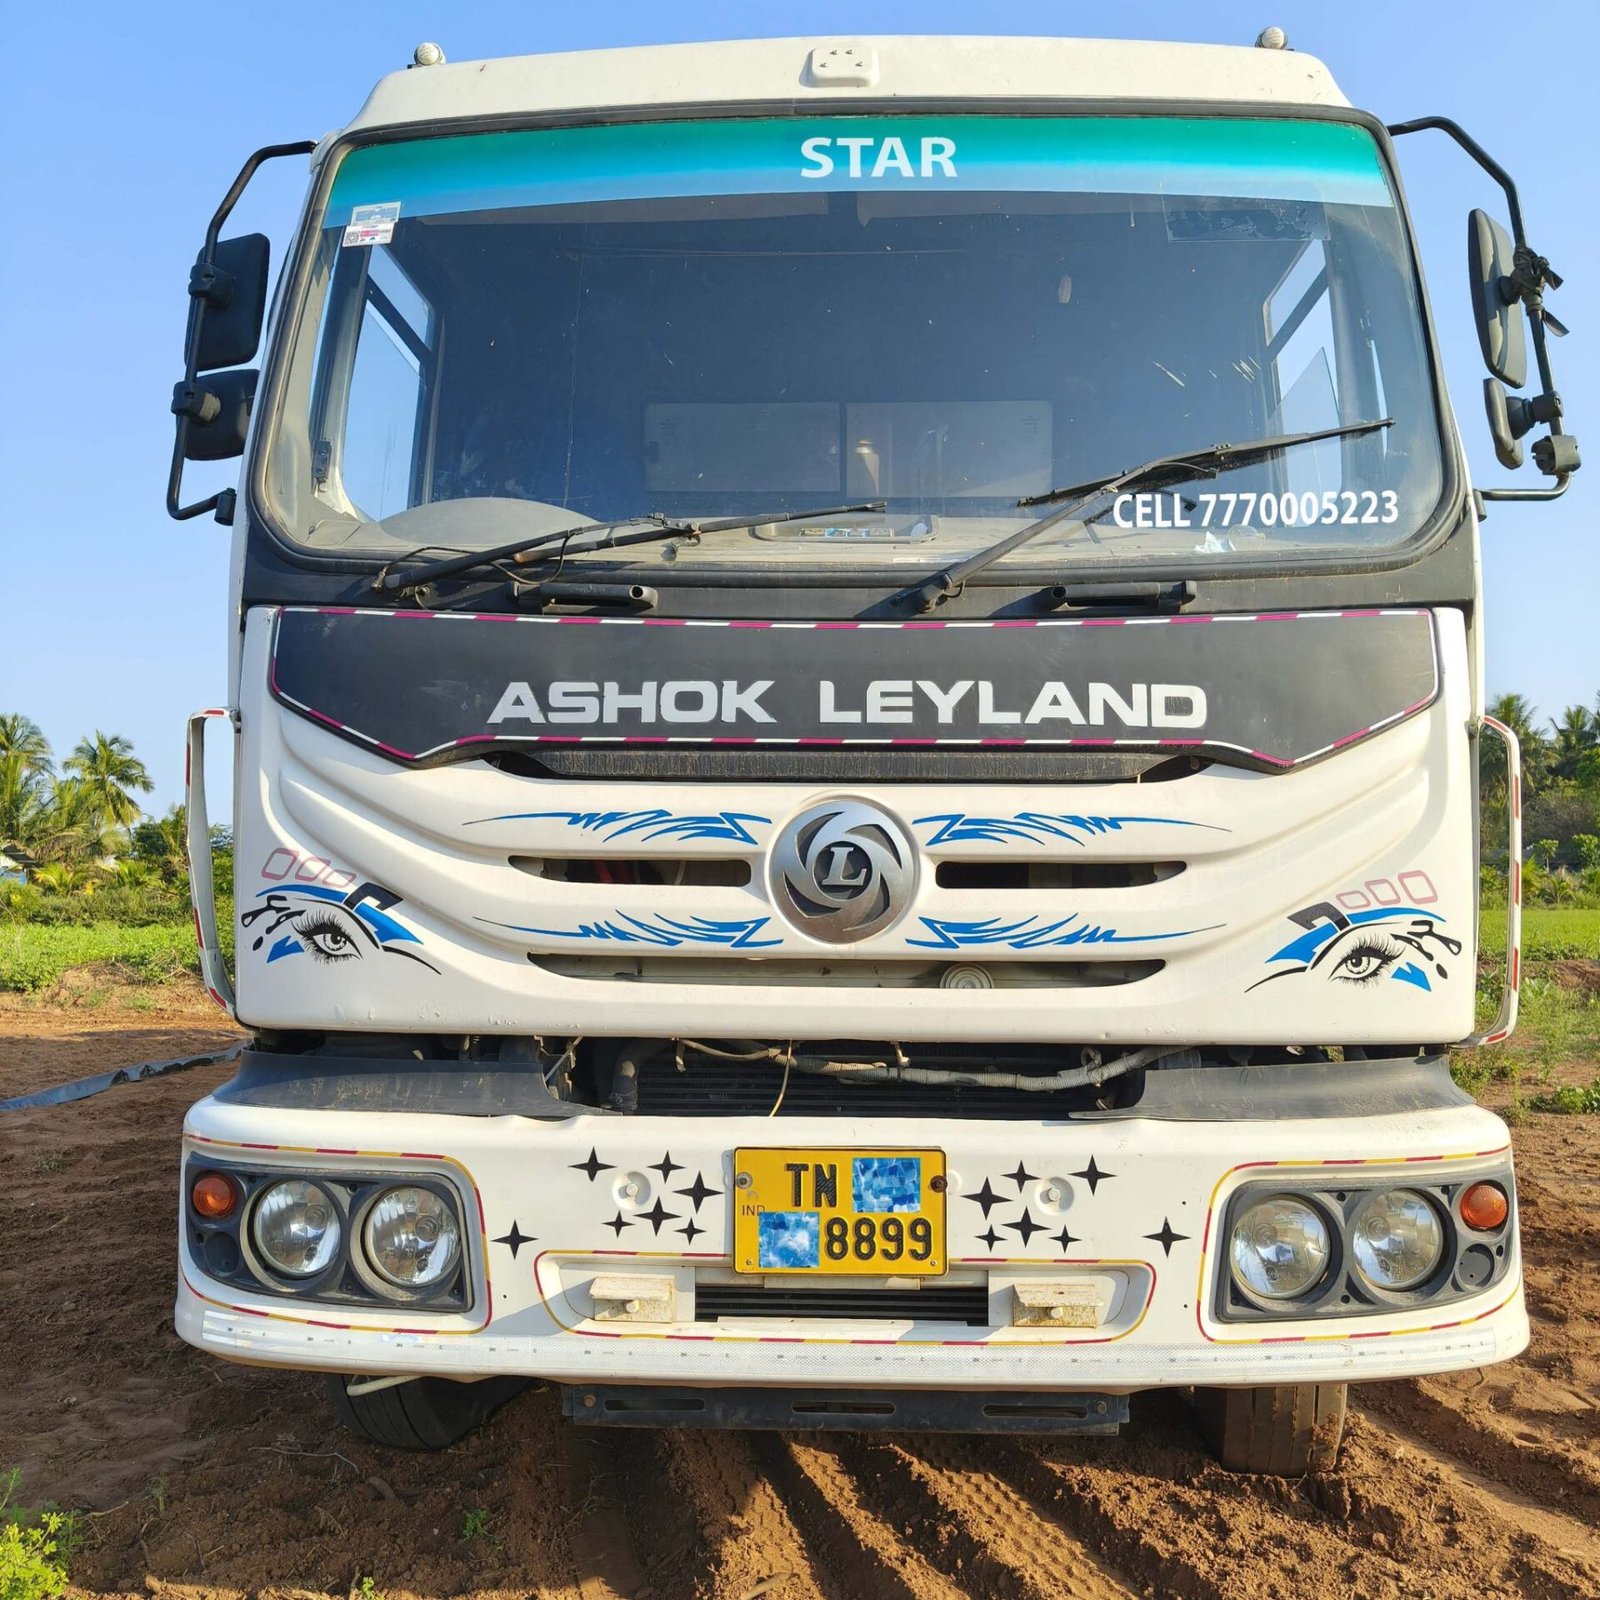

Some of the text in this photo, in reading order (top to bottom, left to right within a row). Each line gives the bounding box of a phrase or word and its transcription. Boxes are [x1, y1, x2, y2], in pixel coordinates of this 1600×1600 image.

[800, 136, 958, 179] STAR
[1112, 490, 1399, 528] CELL 7770005223
[486, 680, 1207, 729] ASHOK LEYLAND
[821, 847, 867, 886] L
[786, 1163, 838, 1208] TN
[826, 1217, 932, 1261] 8899
